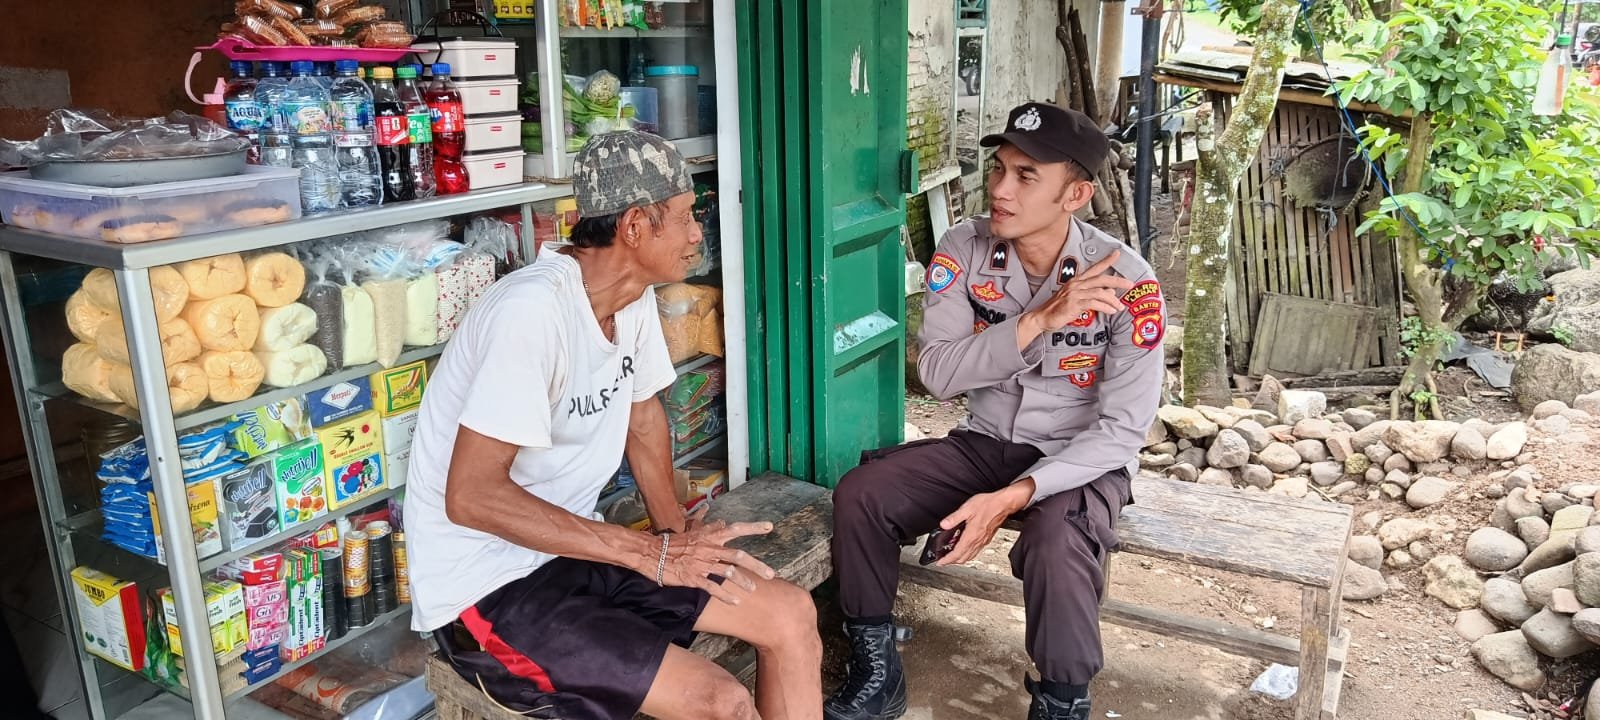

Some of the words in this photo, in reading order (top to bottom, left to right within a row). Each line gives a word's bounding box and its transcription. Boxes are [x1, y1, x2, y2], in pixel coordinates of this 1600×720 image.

[231, 105, 262, 118] AQUA
[330, 389, 352, 401] Merpati
[84, 583, 105, 599] JUMBO
